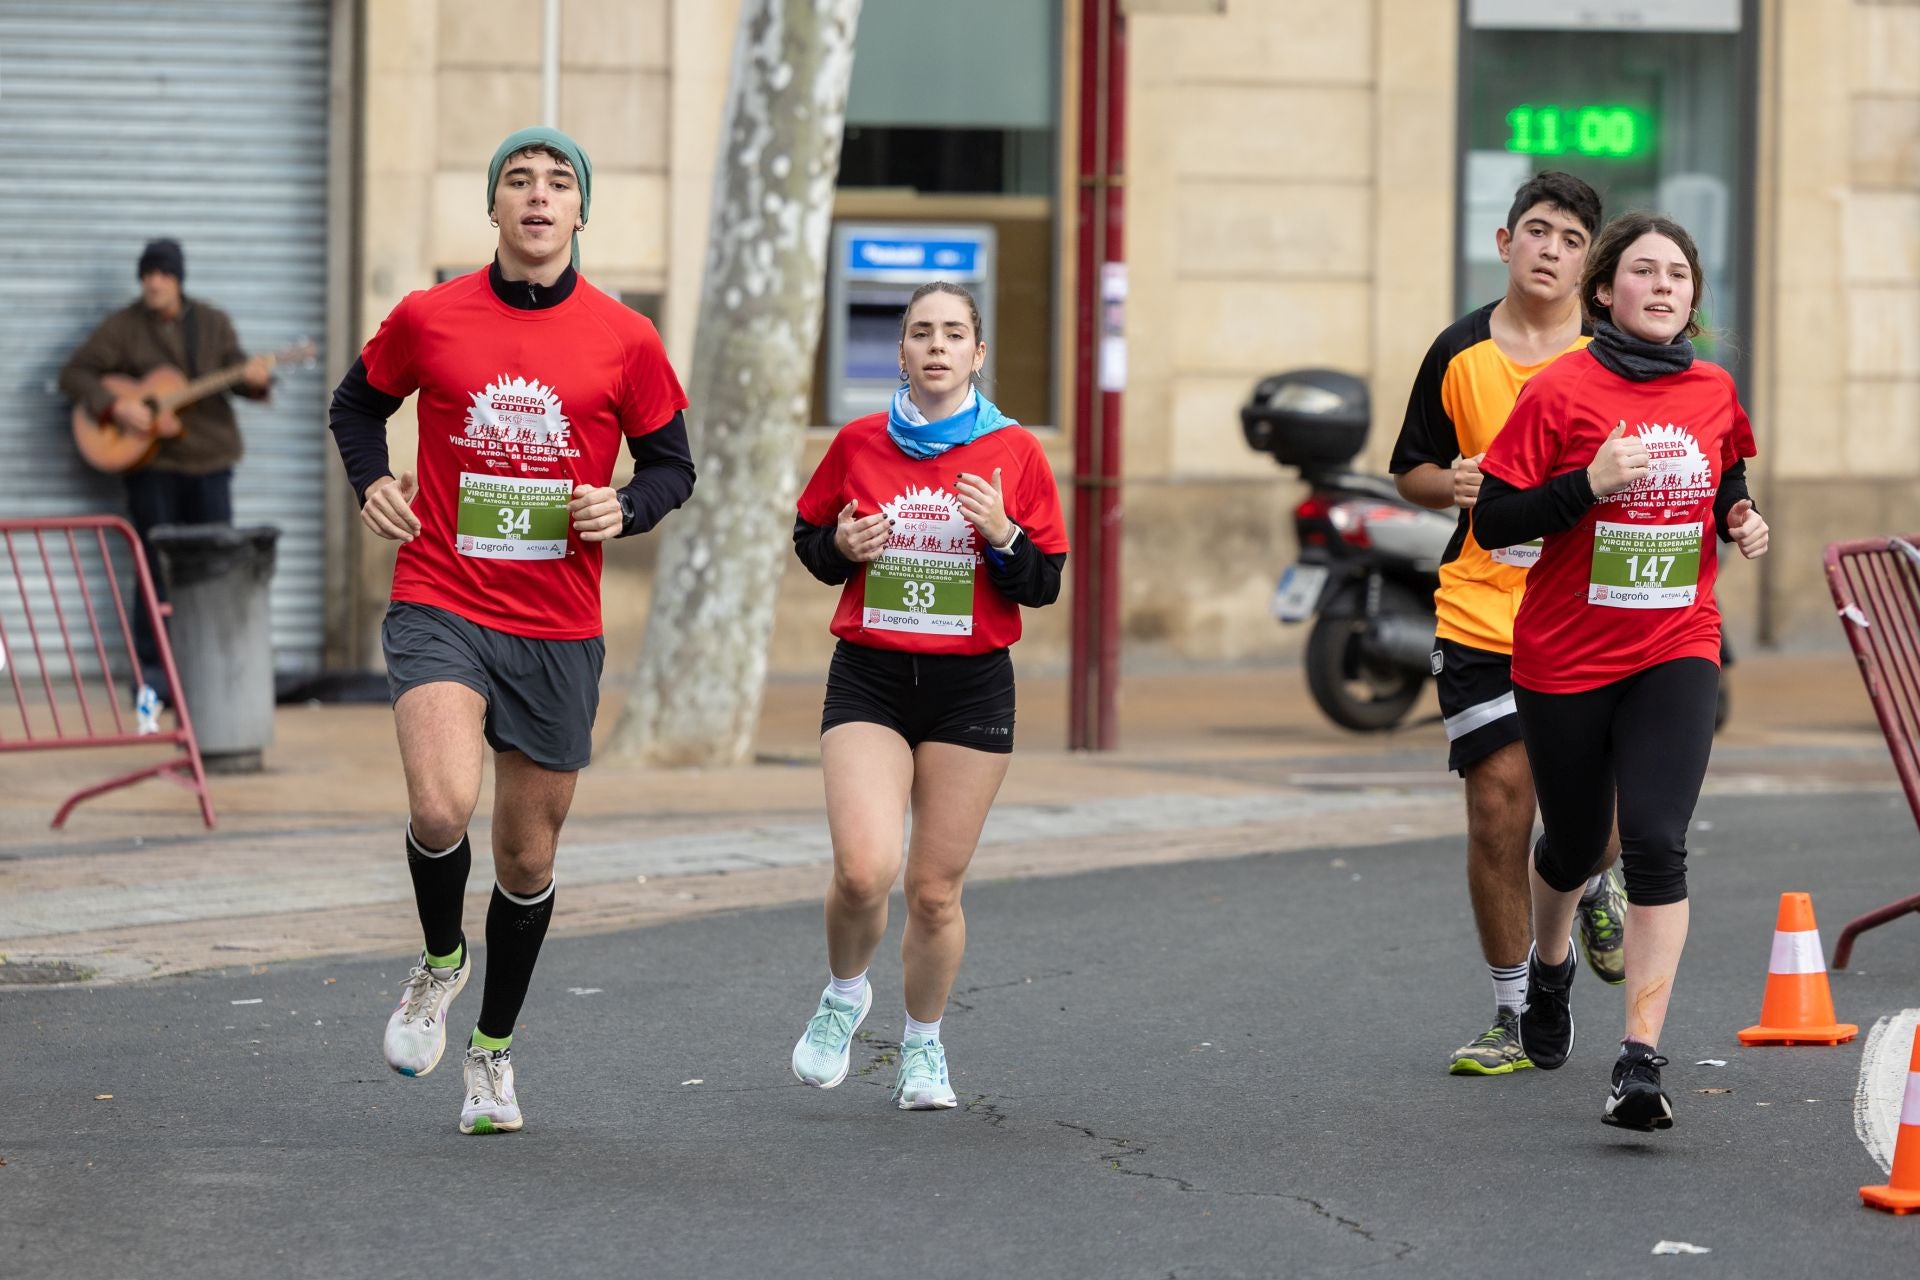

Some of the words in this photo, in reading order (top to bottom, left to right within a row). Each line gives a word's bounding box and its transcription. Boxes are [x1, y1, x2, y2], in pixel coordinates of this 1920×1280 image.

[1505, 105, 1635, 156] 11:00
[492, 393, 545, 406] CARRERA
[493, 403, 543, 414] POPULAR
[449, 435, 485, 449] VIRGEN
[488, 441, 502, 450] DE
[505, 443, 519, 453] LA
[523, 445, 580, 458] ESPERANZA
[1645, 440, 1685, 450] ARRERA
[523, 454, 558, 462] LOGROÑO
[464, 480, 515, 493] CARRERA
[519, 485, 569, 494] POPULAR
[467, 489, 495, 498] VIRGEN
[1633, 492, 1647, 500] DE
[1650, 491, 1664, 500] LA
[1667, 498, 1698, 506] LOGROÑO
[900, 503, 949, 513] CARRERA
[497, 507, 532, 534] 34
[900, 512, 947, 520] POPULAR
[904, 522, 918, 530] 6K
[1600, 529, 1652, 540] CARRERA
[1656, 529, 1700, 540] POPULAR
[476, 541, 514, 552] Logroño
[1602, 538, 1632, 546] VIRGEN
[1658, 539, 1697, 547] ESPERANZA
[877, 555, 919, 566] ARRERA
[922, 559, 972, 569] POPULAR
[873, 563, 900, 572] VIRGEN
[925, 567, 970, 577] ESPERANZA
[1626, 555, 1676, 582] 147
[902, 580, 936, 608] 33
[1610, 590, 1649, 601] Logroño
[909, 606, 928, 614] CELIA
[882, 613, 919, 625] Logroño
